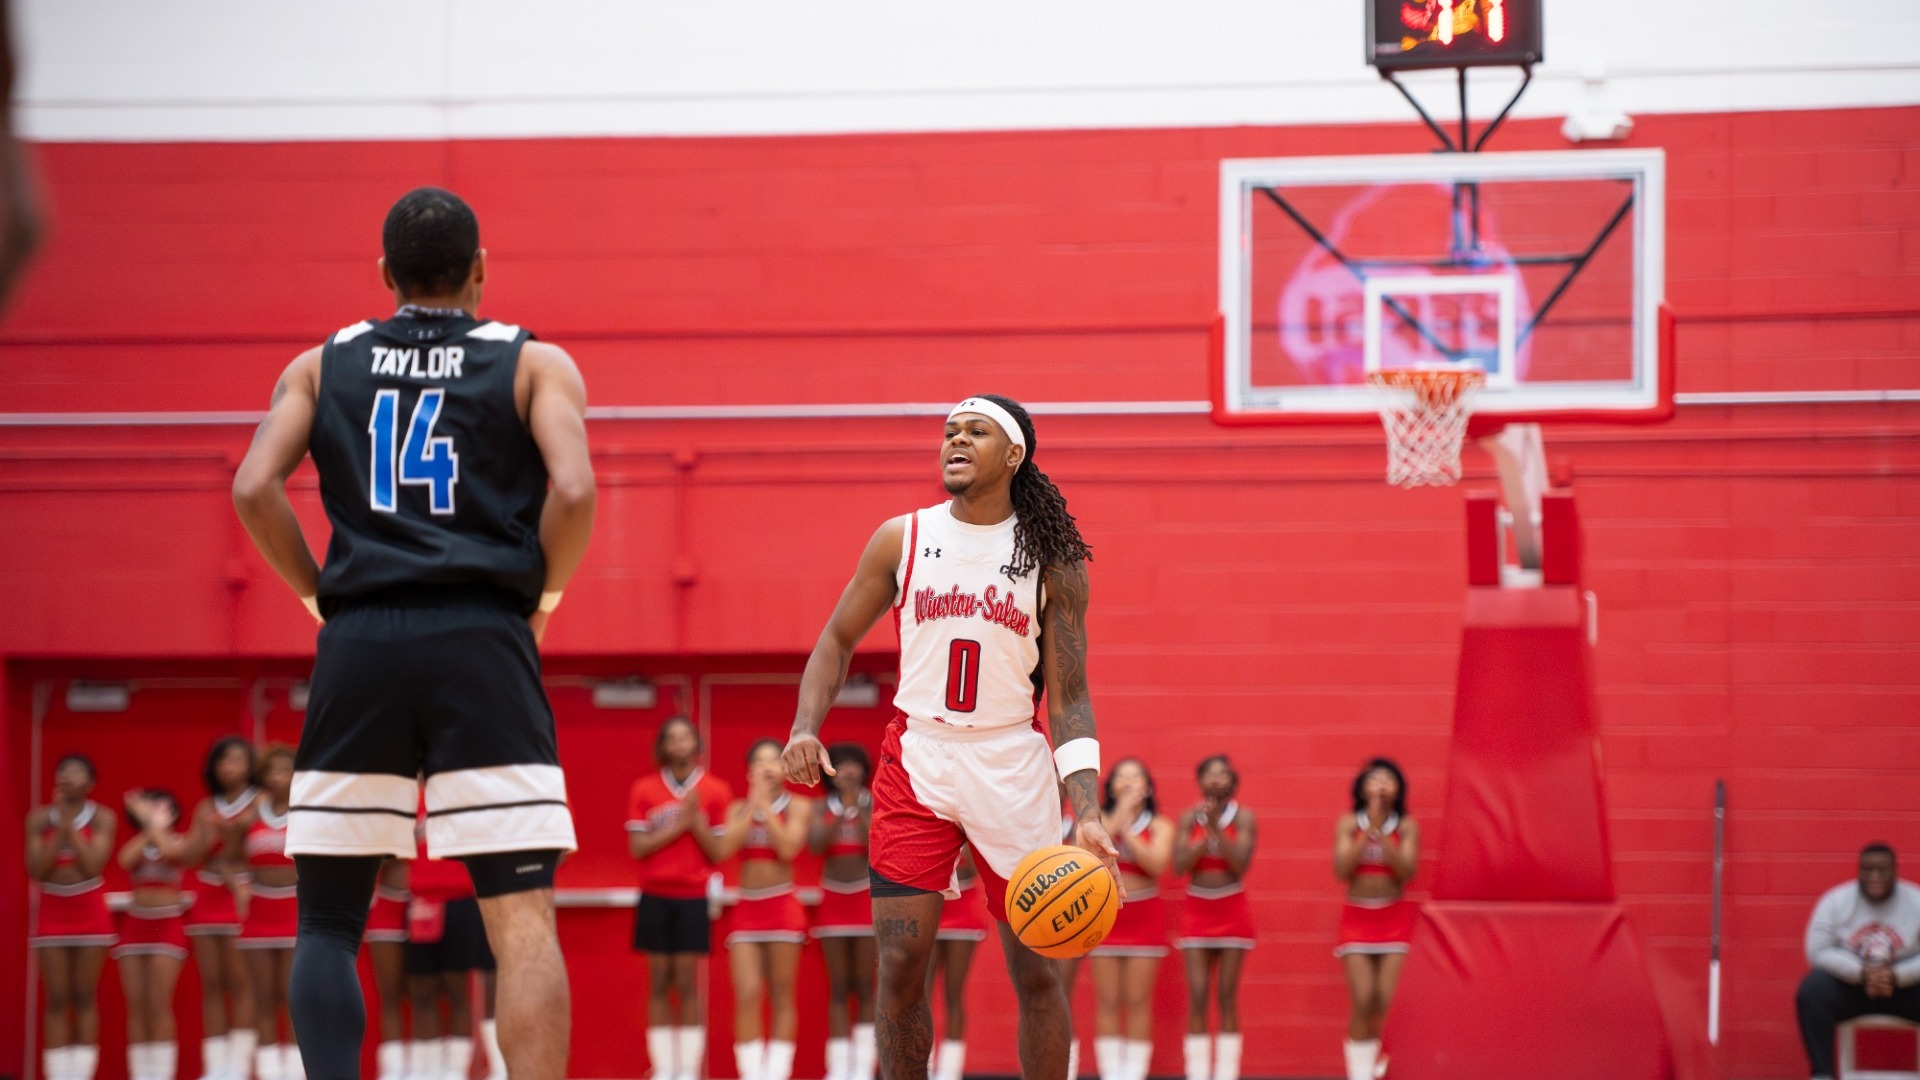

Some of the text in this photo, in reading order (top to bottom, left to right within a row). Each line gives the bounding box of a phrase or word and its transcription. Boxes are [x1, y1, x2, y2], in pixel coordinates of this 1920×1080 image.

[371, 346, 465, 379] TAYLOR
[368, 388, 459, 516] 14
[914, 584, 1031, 638] Winston-Salem
[945, 638, 981, 713] 0
[1015, 860, 1081, 913] Wilson
